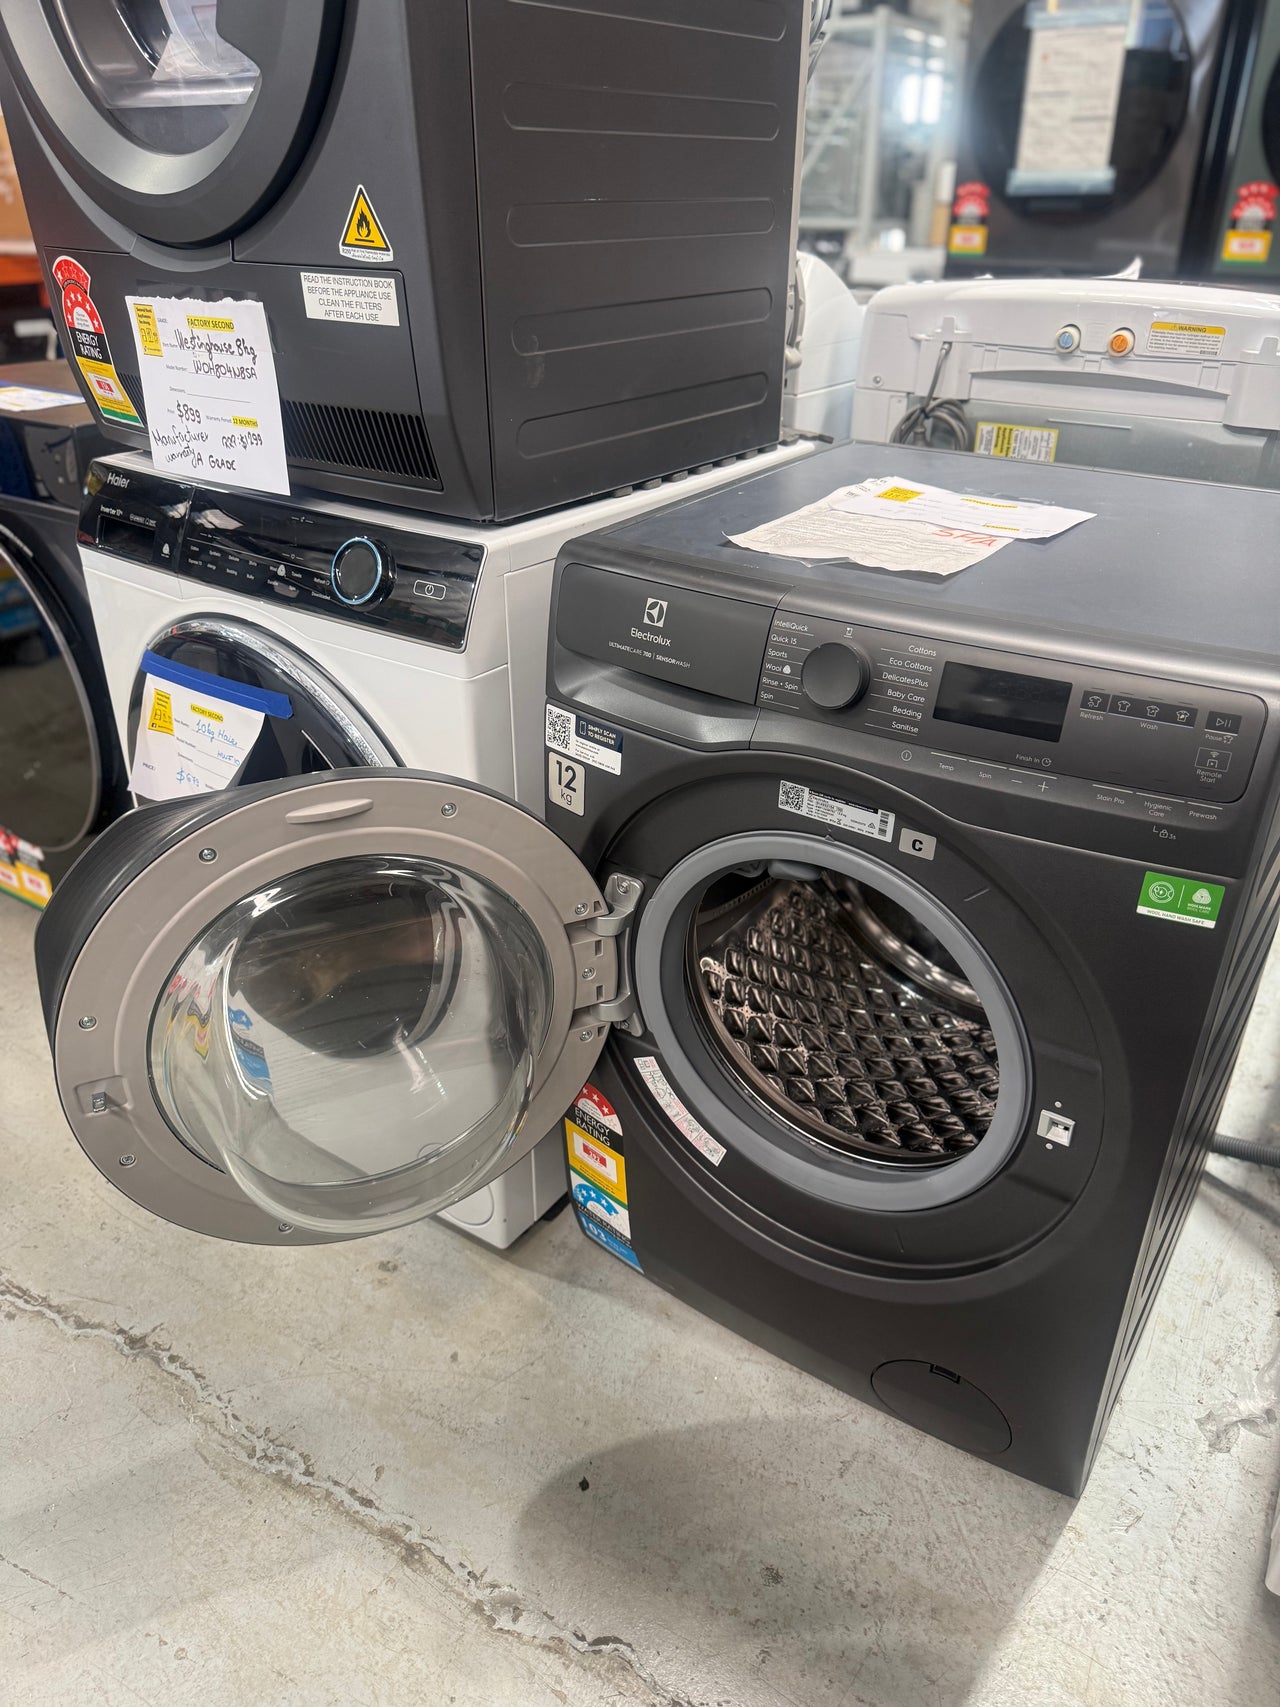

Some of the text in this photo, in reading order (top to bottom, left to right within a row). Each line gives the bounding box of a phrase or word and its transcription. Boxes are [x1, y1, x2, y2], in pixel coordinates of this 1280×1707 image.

[303, 275, 393, 289] READ THE INSTRUCTION BOOK
[307, 287, 392, 300] BEFORE THE APPLIANCE USE
[318, 298, 382, 311] CLEAN THE FILTERS
[324, 310, 379, 322] AFTER EACH USE
[187, 318, 235, 330] FACTORY SECOND
[1178, 325, 1207, 334] WARNING
[75, 331, 99, 347] ENERGY
[174, 328, 235, 360] Westinghouse
[81, 347, 103, 360] RATING
[176, 400, 202, 424] $899
[106, 472, 130, 489] Haier
[774, 619, 809, 632] IntelliQuick
[630, 627, 672, 647] Electrolux
[771, 633, 797, 645] Quick 15
[608, 640, 642, 656] ULTIMATECARE
[655, 654, 691, 669] SENSORWASH
[767, 648, 788, 659] Sports
[908, 644, 937, 657] Cottons
[765, 662, 782, 672] Wool
[889, 657, 933, 673] Eco Cottons
[762, 676, 799, 691] Rinse Spin
[882, 672, 929, 688] DelicatesPlus
[760, 691, 774, 700] Spin
[887, 688, 926, 703] Baby Care
[892, 706, 922, 720] Bedding
[1080, 711, 1104, 721] Refresh
[587, 724, 617, 739] SIMPLY SCAN
[891, 721, 919, 734] Sanitise
[1139, 721, 1159, 730] Wash
[594, 734, 615, 745] REGISTER
[1204, 733, 1222, 742] Pause
[1015, 753, 1033, 763] Finish
[939, 762, 954, 771] Temp
[556, 760, 577, 793] 12
[978, 771, 992, 779] Spin
[1196, 769, 1222, 779] Remote
[1200, 776, 1216, 784] Start
[560, 788, 573, 806] kg
[1096, 794, 1125, 805] Stain Pro
[1144, 801, 1172, 812] Hygienic
[1148, 809, 1165, 818] Care
[1188, 810, 1217, 821] Prewash
[911, 838, 924, 852] C
[1161, 911, 1176, 919] HAND
[574, 1107, 610, 1136] ENERGY
[576, 1117, 611, 1146] RATING
